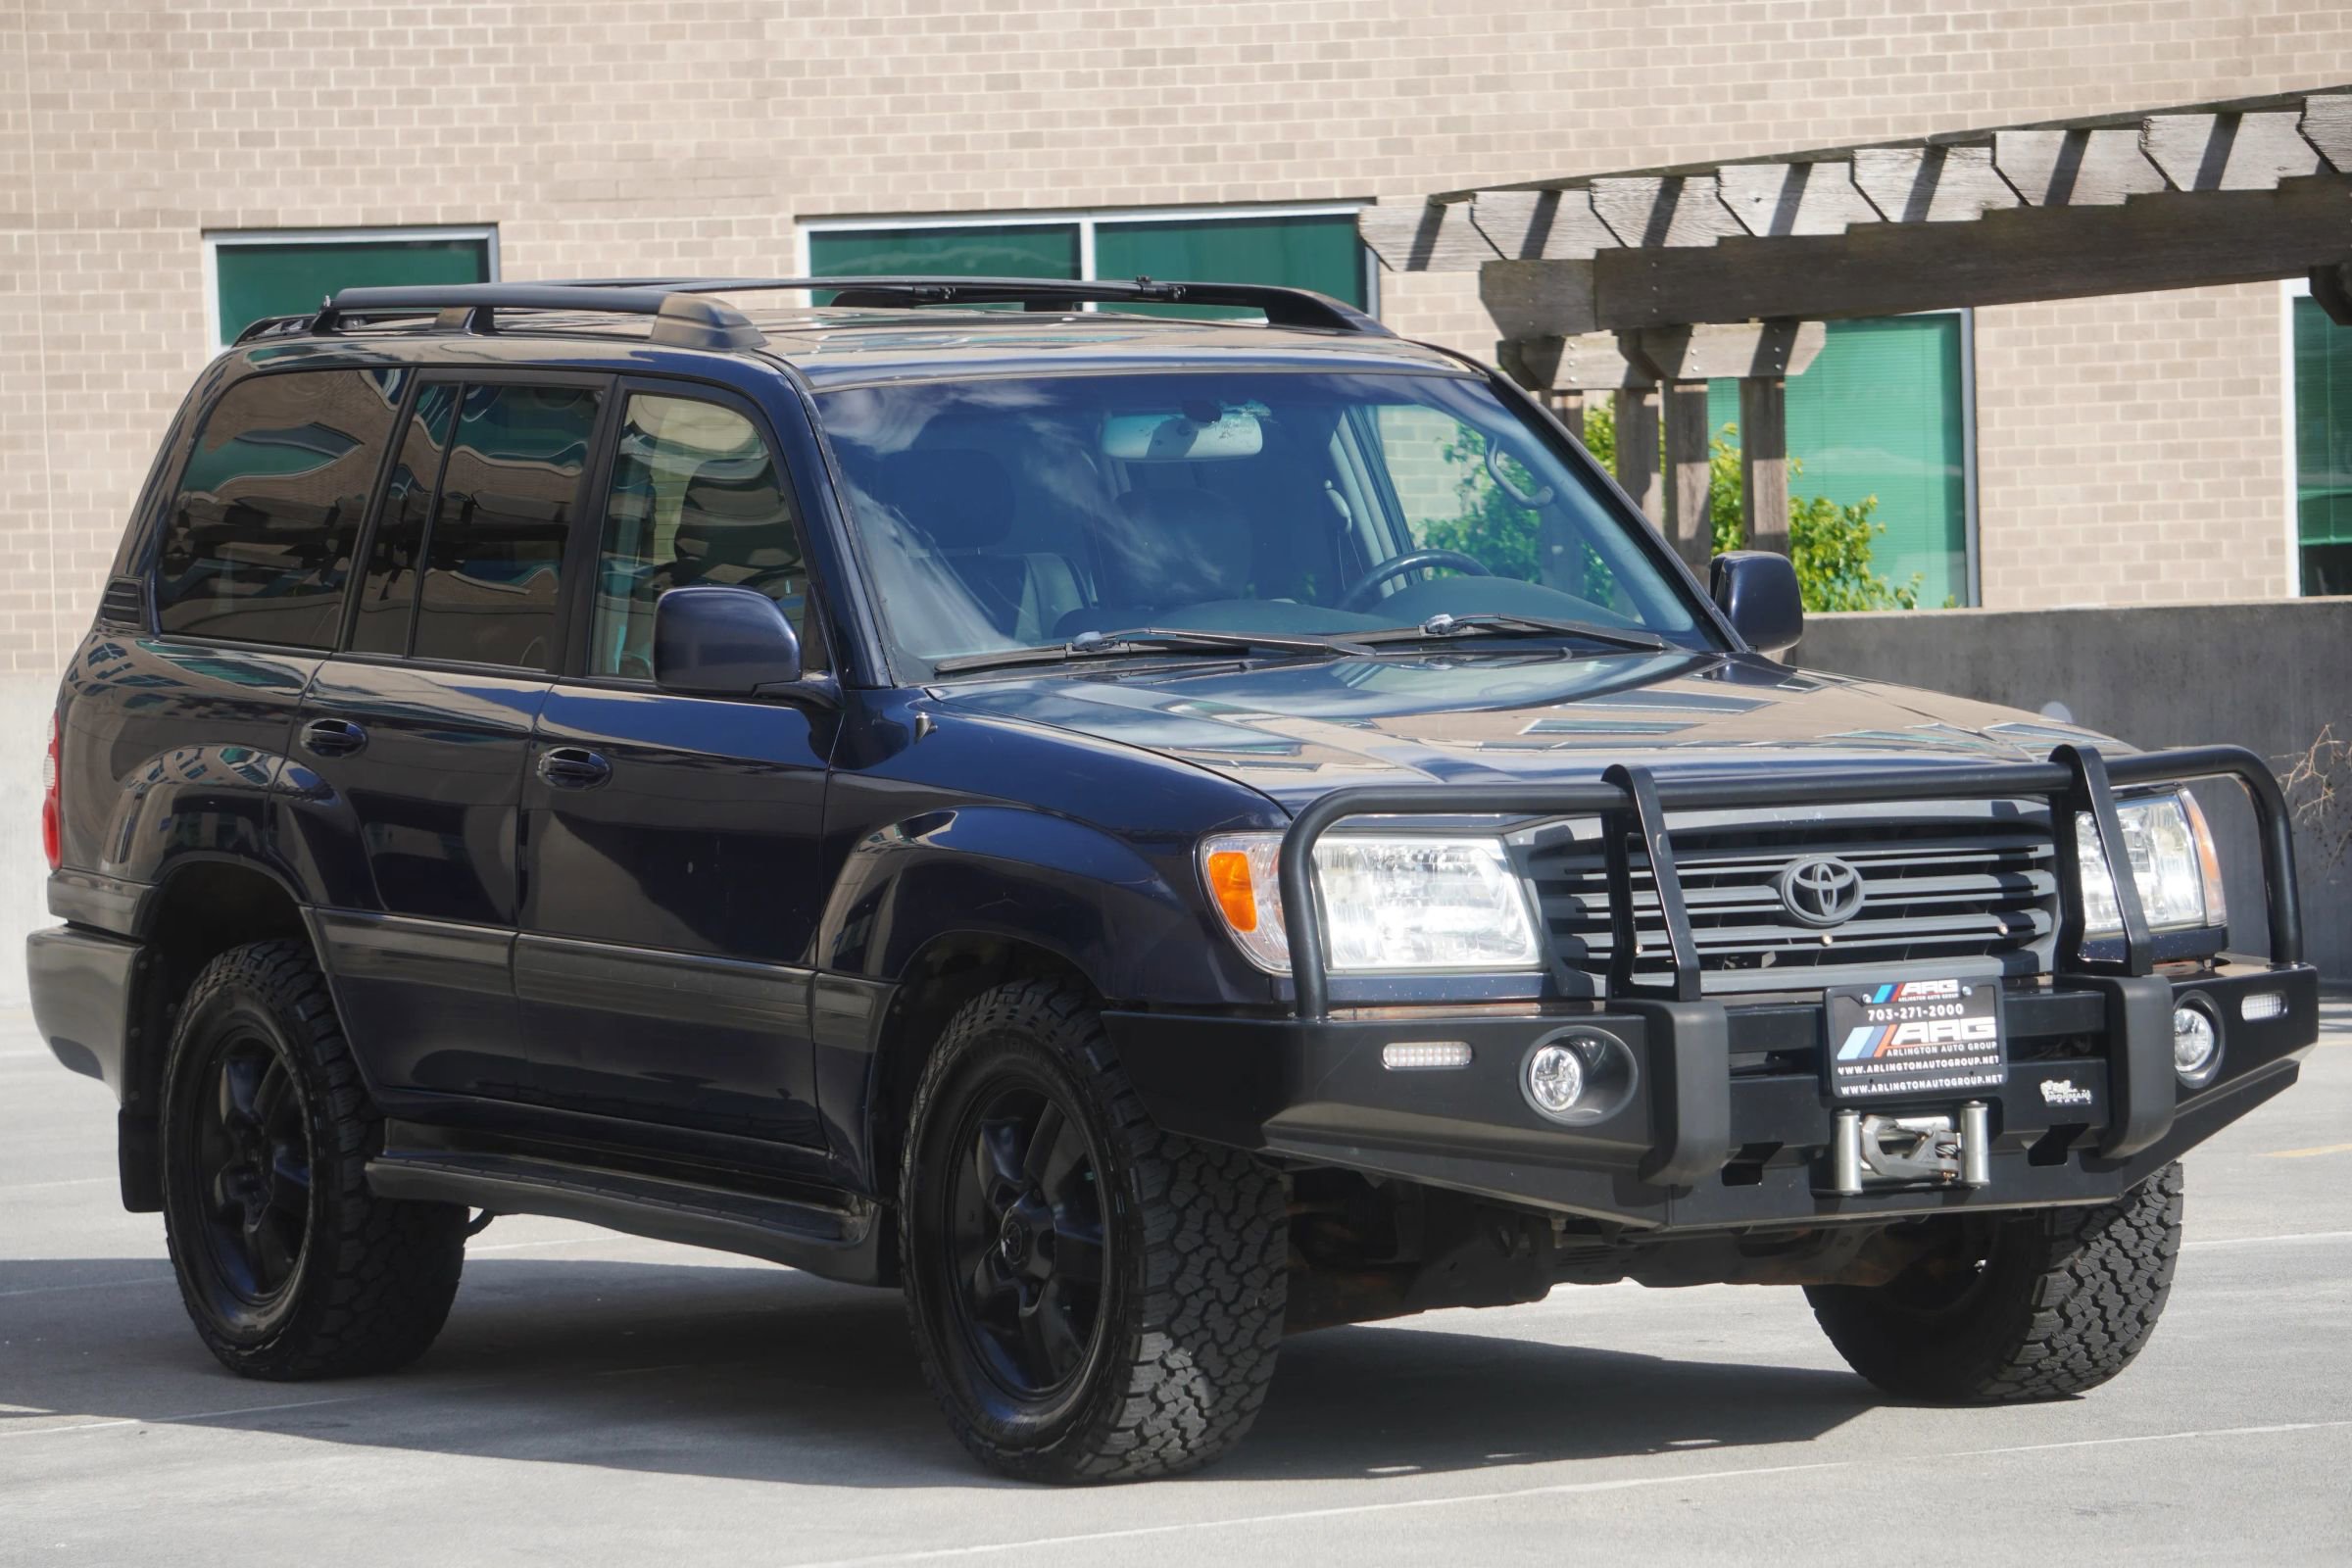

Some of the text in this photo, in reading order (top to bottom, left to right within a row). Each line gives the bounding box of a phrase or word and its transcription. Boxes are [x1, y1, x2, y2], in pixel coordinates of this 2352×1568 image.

[1899, 979, 1958, 996] AAG
[1867, 1003, 1964, 1022] 703-271-2000
[1890, 1016, 1996, 1046] AAG
[1886, 1041, 1997, 1057] ARLINGTON AUTO GROUP
[1840, 1075, 2003, 1095] WWW.ARLINGTONAUTOGROUP.NET
